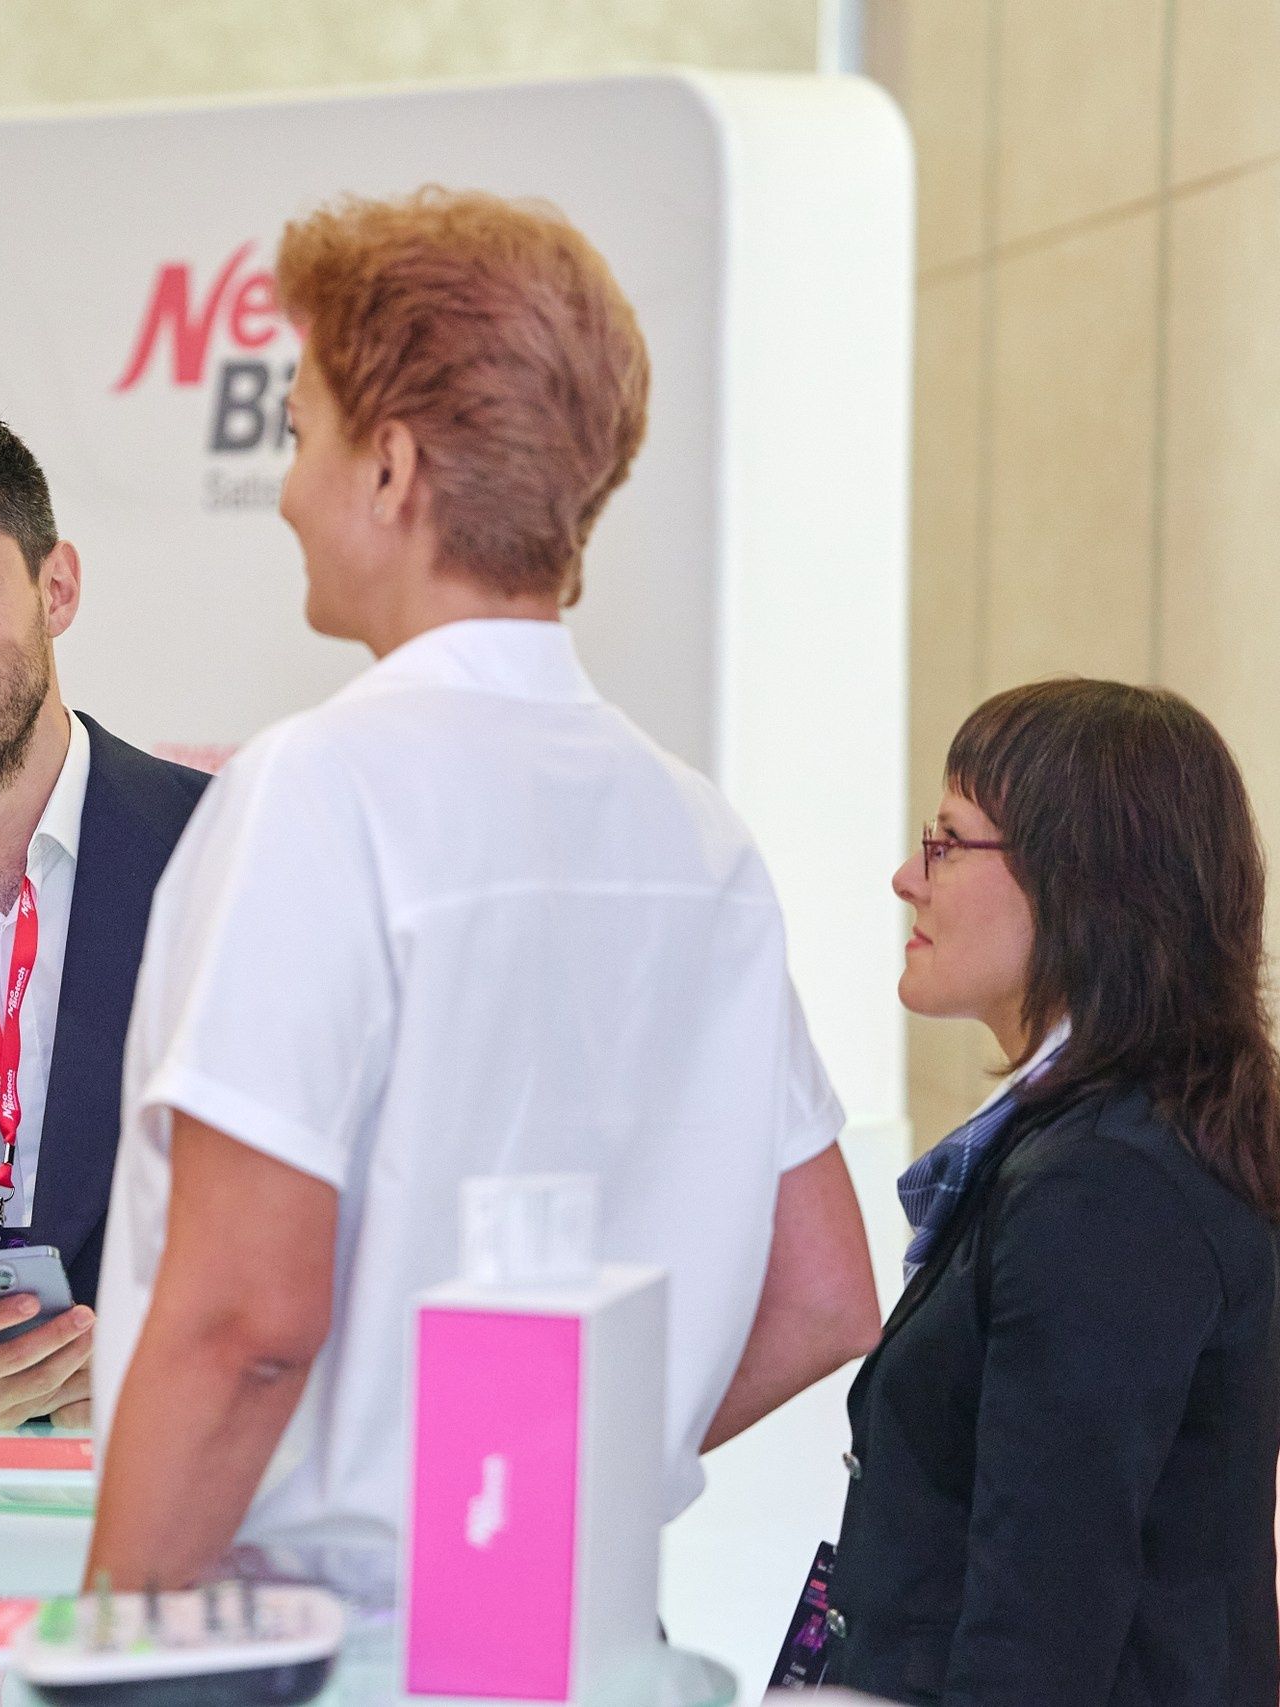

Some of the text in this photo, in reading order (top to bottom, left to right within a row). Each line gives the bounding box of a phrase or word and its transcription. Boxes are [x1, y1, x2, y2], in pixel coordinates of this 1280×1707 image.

[112, 238, 308, 394] Ne
[211, 358, 298, 454] Bi
[6, 990, 15, 1020] Neo
[11, 966, 26, 1009] Biotech
[1, 1093, 14, 1121] Neo
[6, 1069, 16, 1111] Biotech
